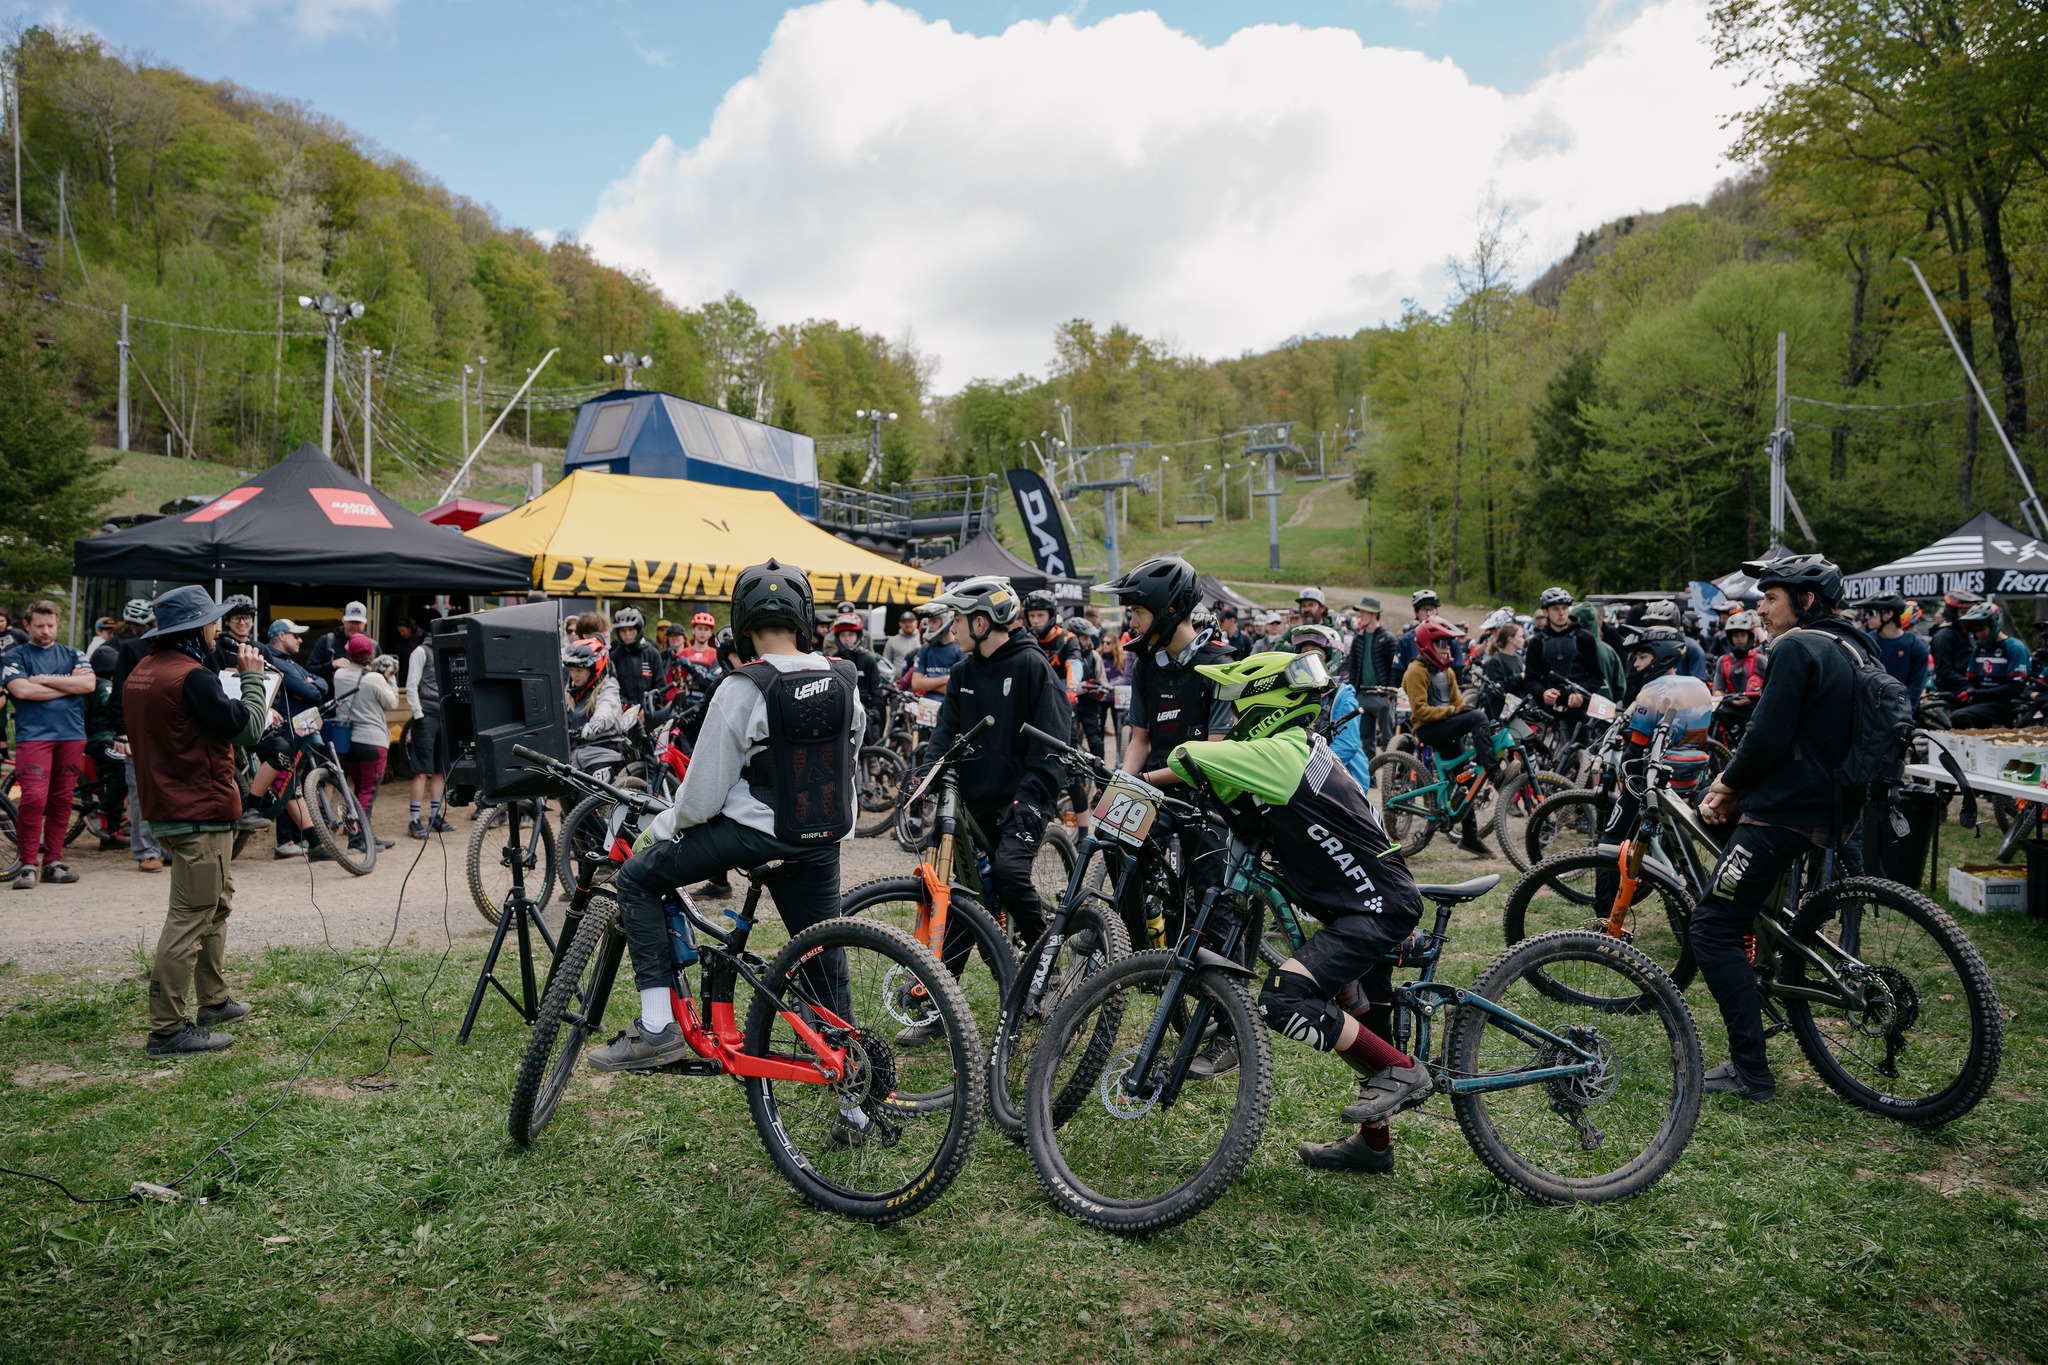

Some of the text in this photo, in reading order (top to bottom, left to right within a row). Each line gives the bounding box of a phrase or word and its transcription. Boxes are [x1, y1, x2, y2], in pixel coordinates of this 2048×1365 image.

[1886, 575, 1900, 592] OF
[1903, 573, 1938, 597] GOOD
[1943, 570, 1985, 594] TIMES
[1996, 569, 2048, 592] FAST
[794, 677, 833, 700] LEATT
[1253, 674, 1279, 688] LEATT
[1157, 708, 1181, 722] LEATT
[1248, 708, 1285, 739] GIRO
[1106, 792, 1148, 833] 89
[801, 831, 834, 840] AIRFLEX
[1307, 823, 1376, 894] CRAFT
[1719, 852, 1750, 894] 100%
[1029, 952, 1054, 990] FOX
[1595, 945, 1656, 980] MAXXIS
[988, 1010, 1008, 1066] MAXXIS
[1879, 1095, 1918, 1108] DT SWISS
[886, 1168, 936, 1208] MAXXIS
[1050, 1176, 1105, 1213] MAXXIS
